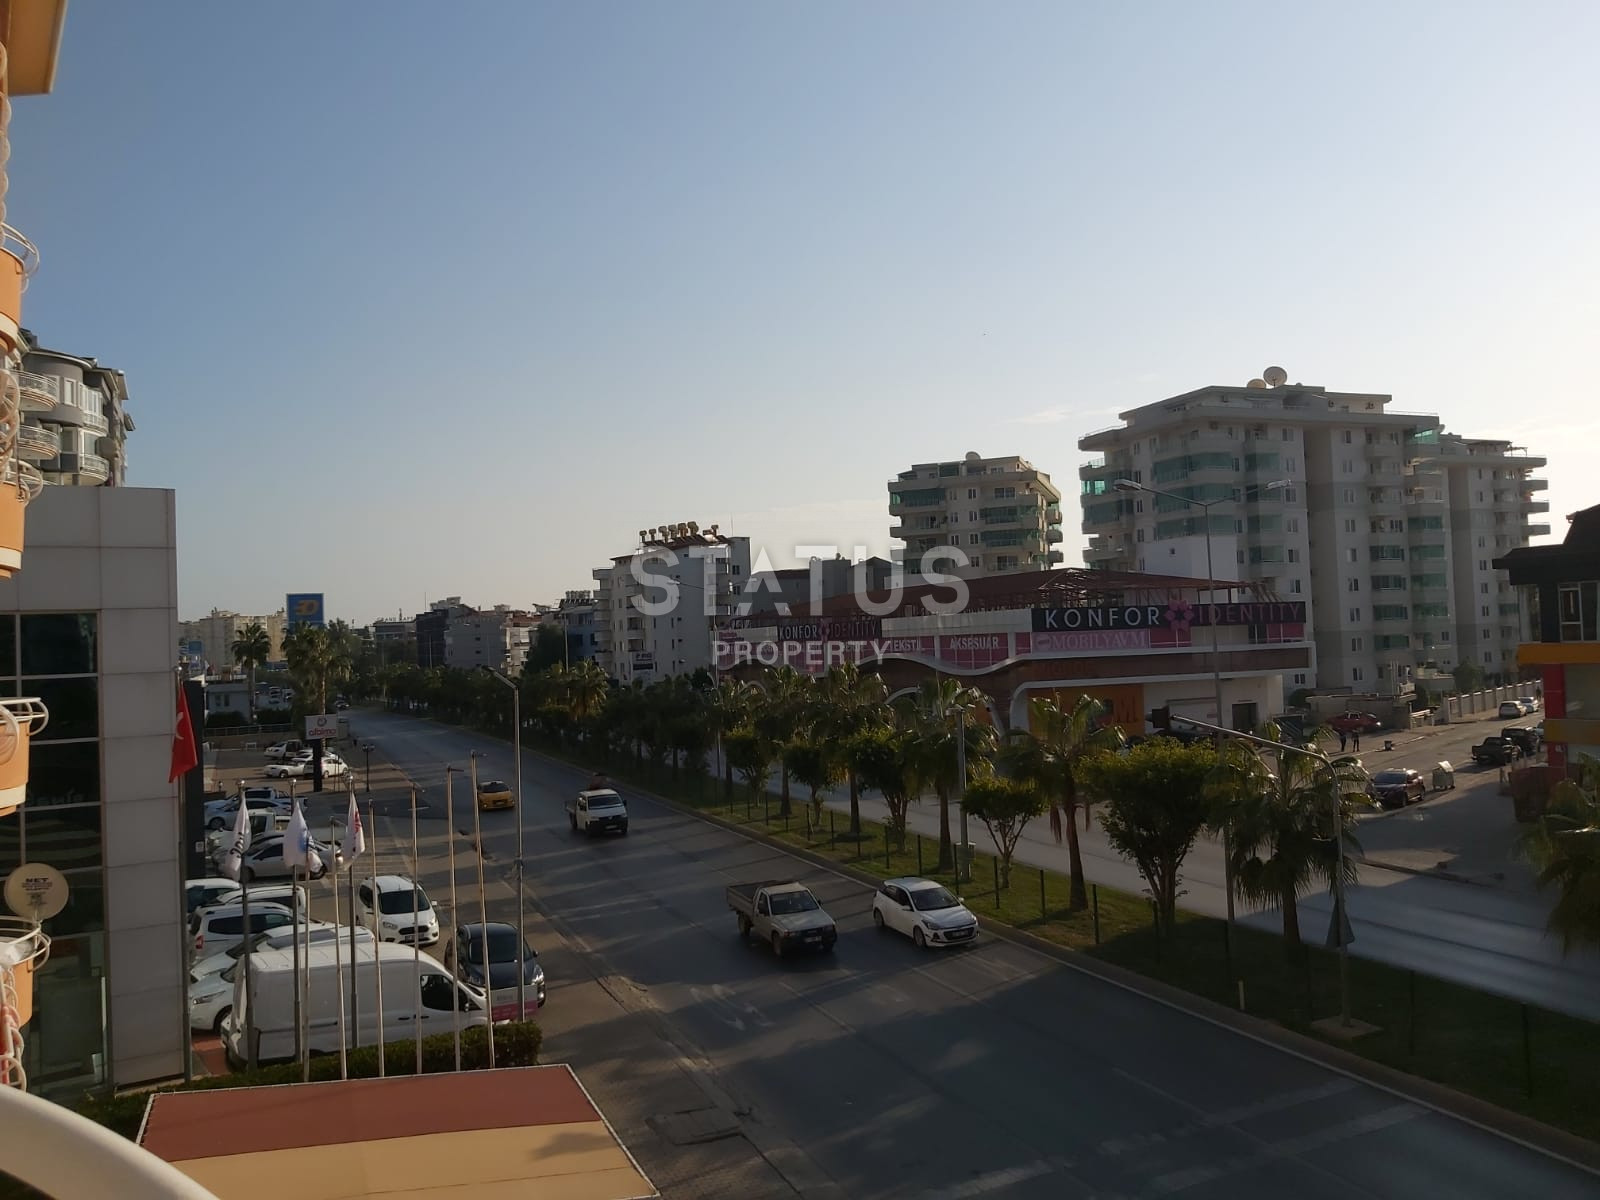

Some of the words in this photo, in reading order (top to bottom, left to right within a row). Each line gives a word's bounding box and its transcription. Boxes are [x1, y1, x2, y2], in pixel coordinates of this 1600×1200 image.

[1045, 606, 1160, 629] KONFOR
[1199, 602, 1301, 624] IDENTITY
[779, 624, 818, 641] KONFOR
[949, 637, 999, 650] AKSESUAR
